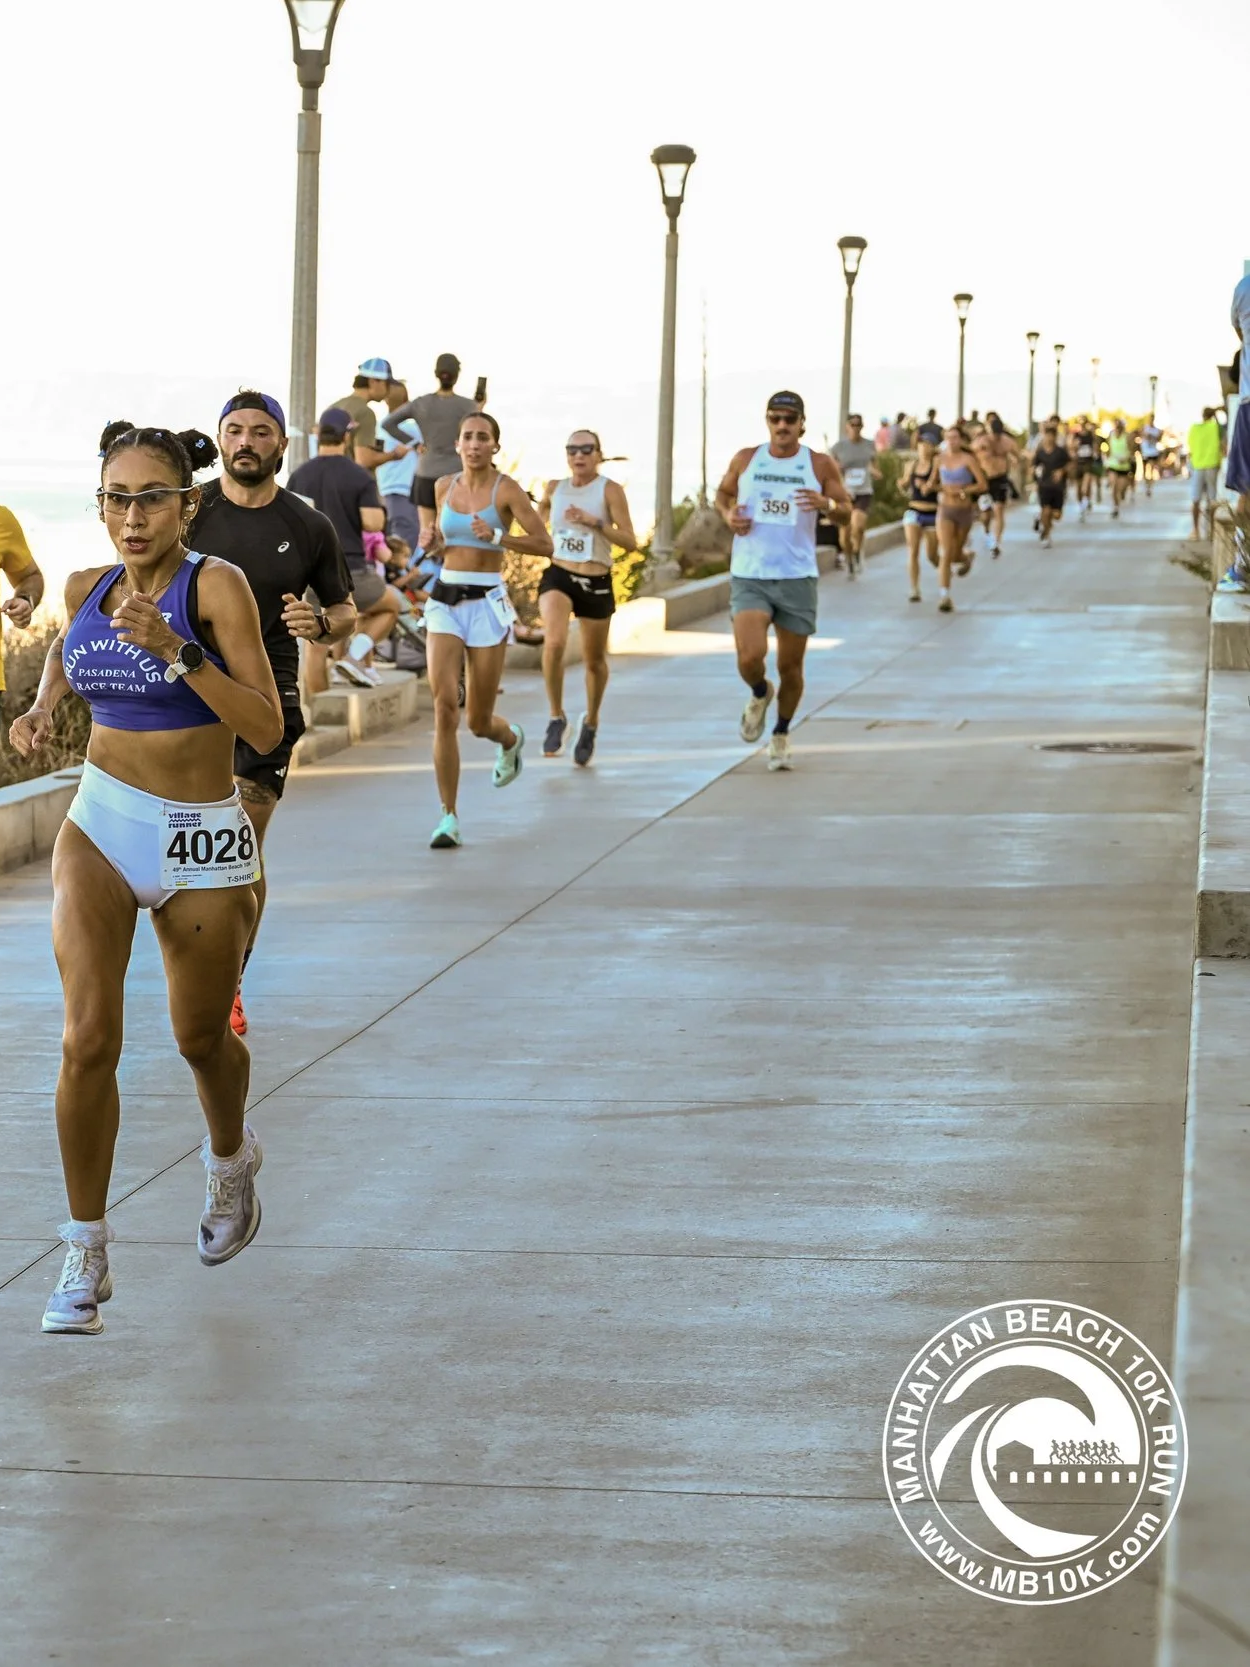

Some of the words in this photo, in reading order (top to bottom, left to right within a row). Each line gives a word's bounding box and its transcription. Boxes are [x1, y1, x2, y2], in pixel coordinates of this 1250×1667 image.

[762, 499, 790, 515] 359
[560, 537, 585, 553] 768
[65, 644, 88, 680] RUN
[90, 639, 142, 660] WITH
[138, 657, 162, 683] US
[78, 668, 136, 678] PASADENA
[76, 682, 107, 691] RACE
[109, 683, 147, 693] TEAM
[166, 824, 254, 865] 4028
[227, 872, 255, 883] T-SHIRT
